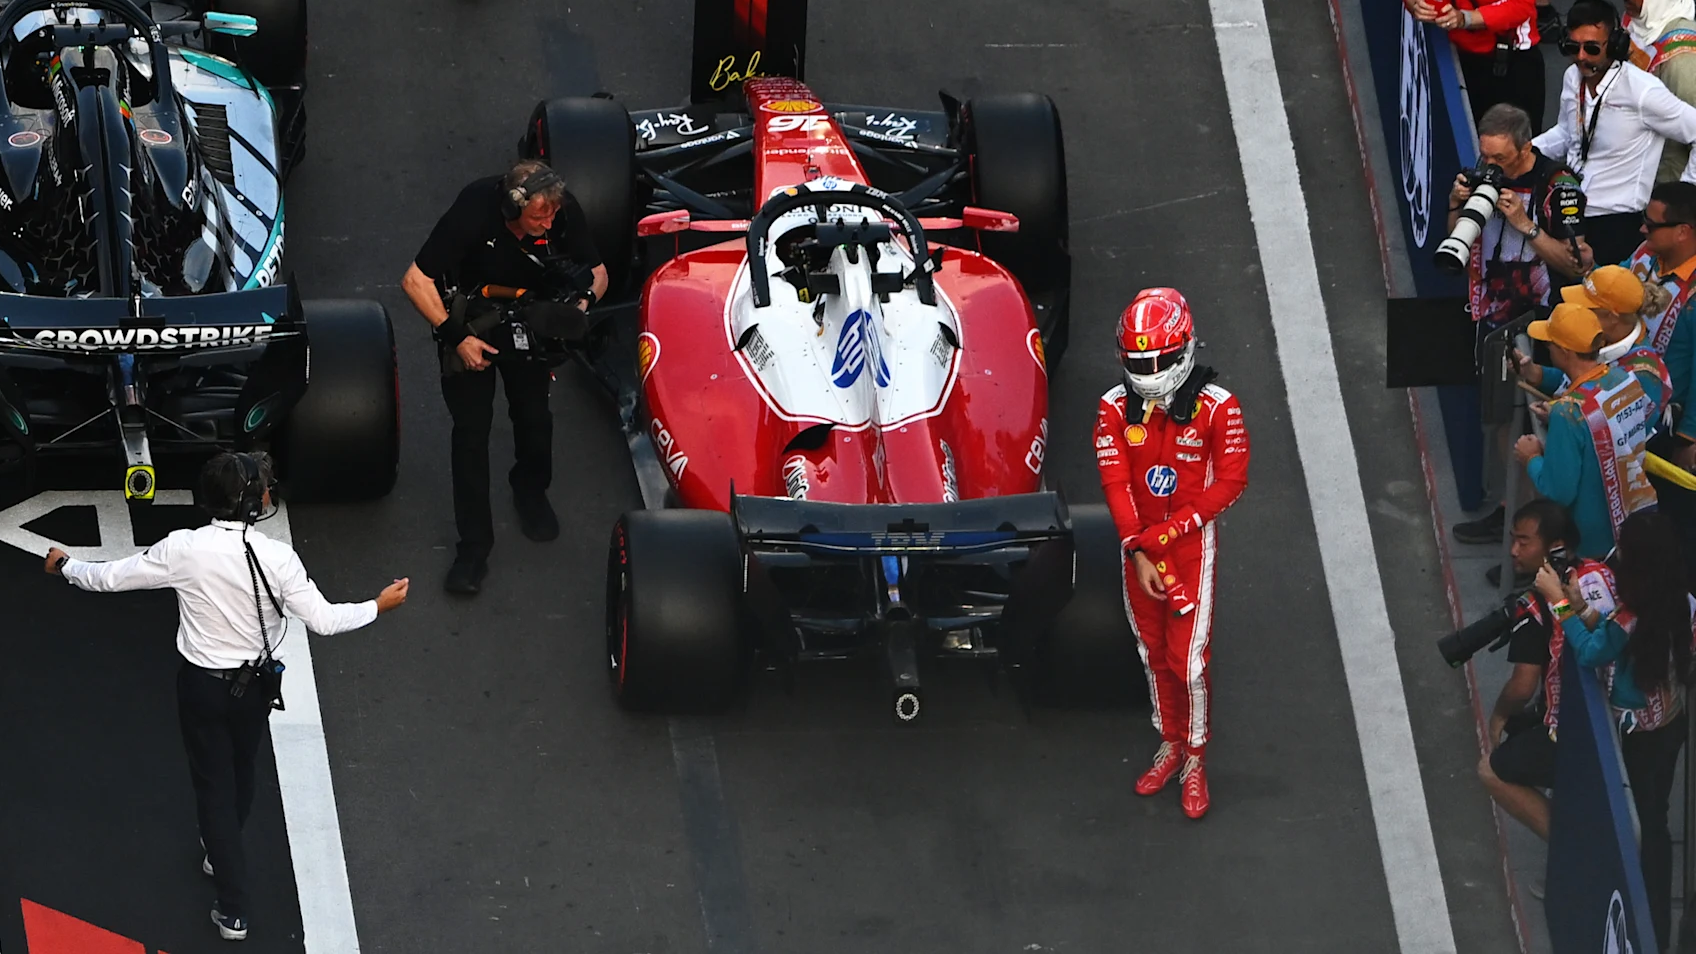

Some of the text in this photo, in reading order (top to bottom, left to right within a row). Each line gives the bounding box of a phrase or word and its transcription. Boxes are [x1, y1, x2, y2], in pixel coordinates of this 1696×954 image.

[709, 50, 765, 92] Bak
[864, 187, 887, 200] IBM
[34, 325, 274, 352] CROWDSTRIKE
[1615, 399, 1644, 424] 0153-AZ
[1151, 466, 1176, 497] hp
[1601, 457, 1625, 527] ERBAIJAN
